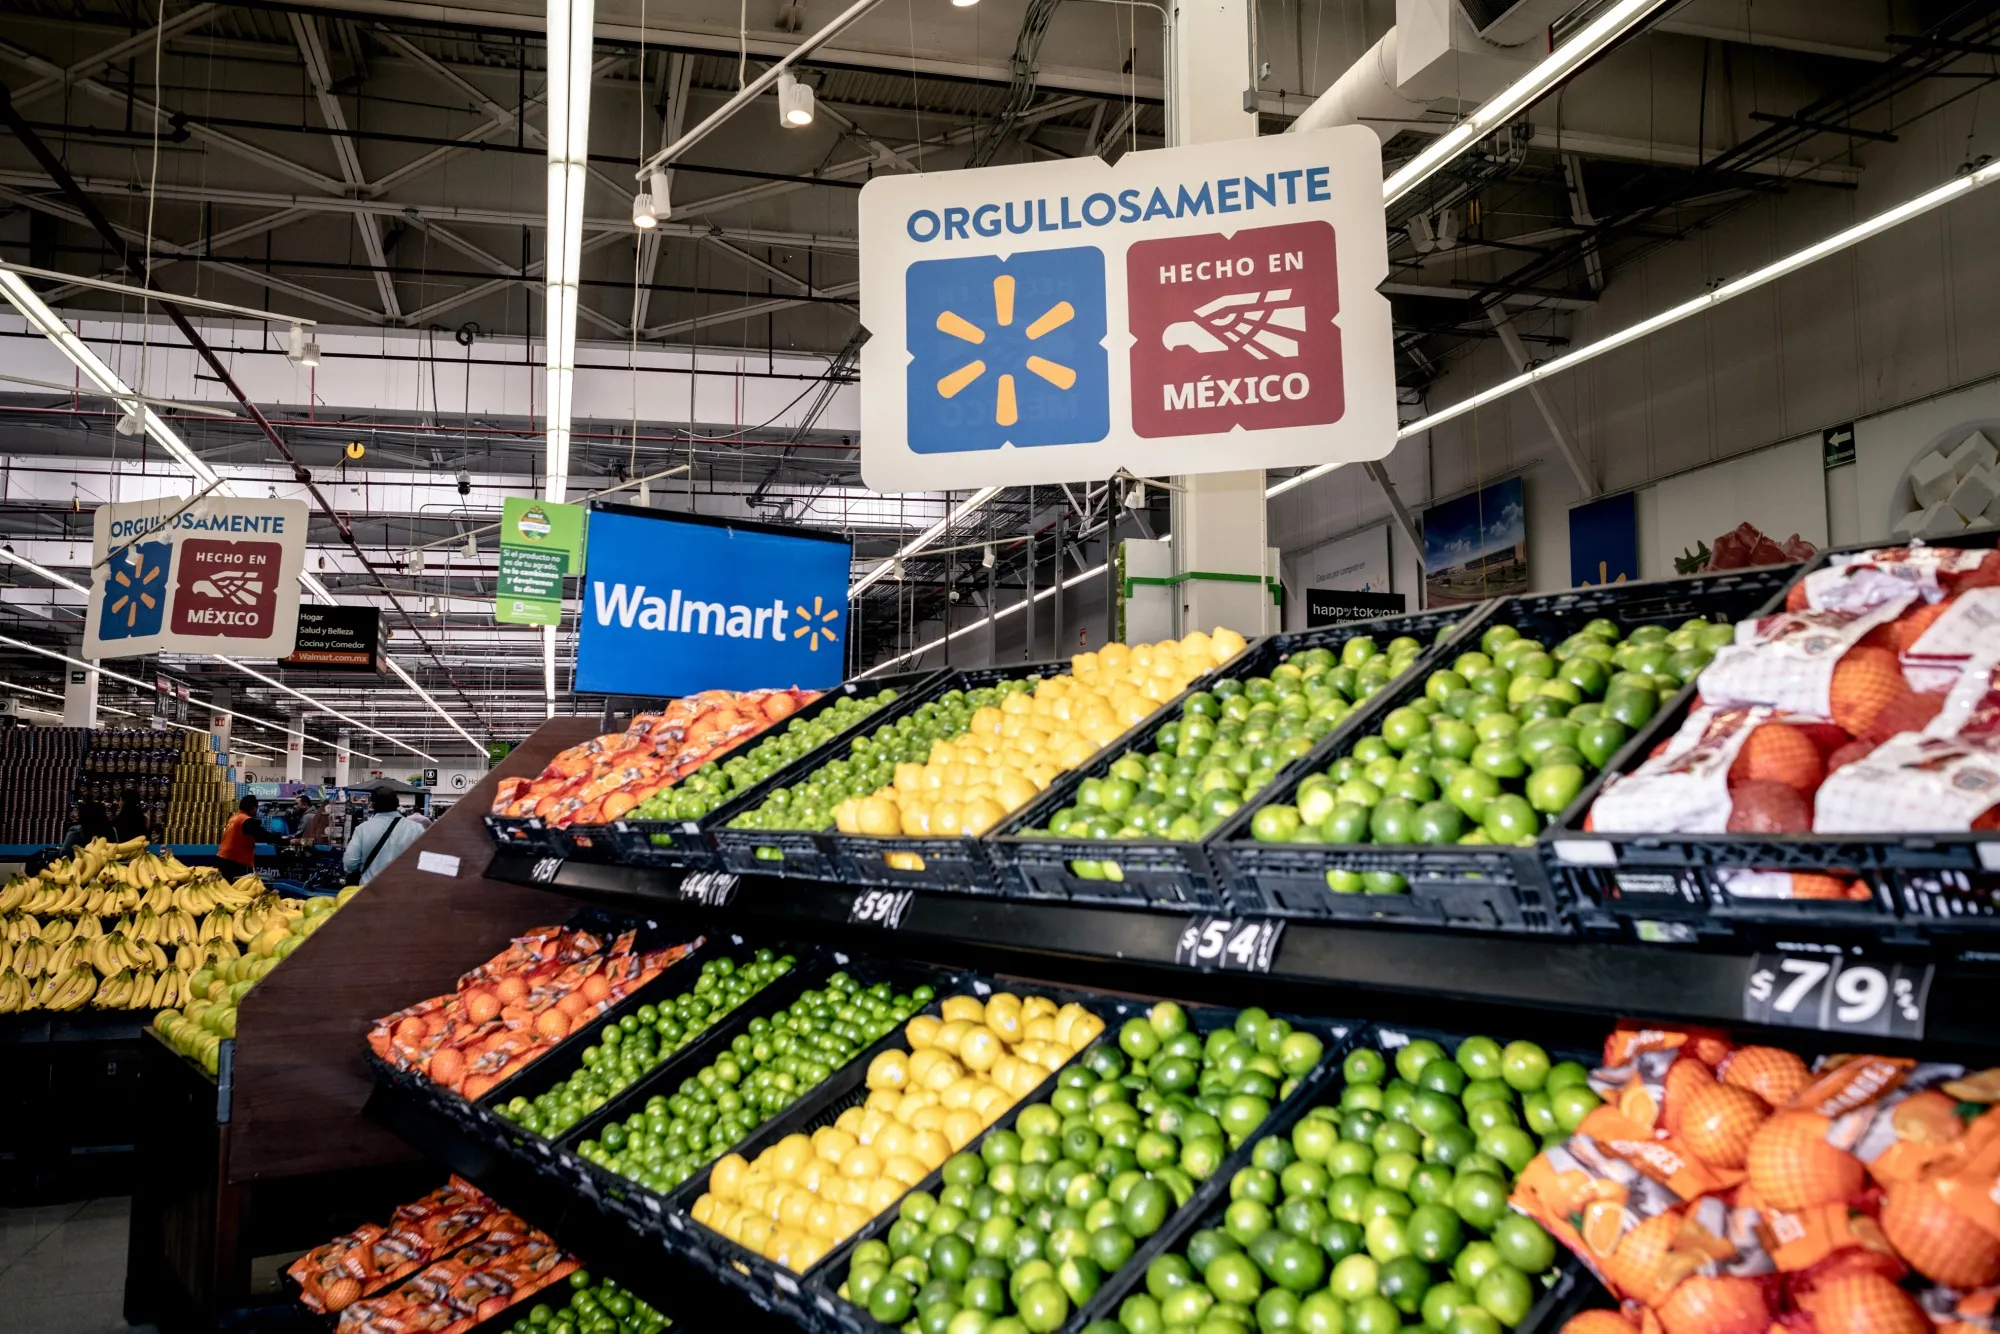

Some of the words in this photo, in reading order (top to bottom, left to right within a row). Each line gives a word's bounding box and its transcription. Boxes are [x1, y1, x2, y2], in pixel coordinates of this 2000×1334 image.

[907, 166, 1331, 243] ORGULLOSAMENTE
[1159, 255, 1254, 284] HECHO
[1269, 251, 1304, 273] EN
[1163, 372, 1310, 412] MÉXICO
[196, 552, 243, 564] HECHO
[249, 554, 266, 565] EN
[518, 552, 551, 561] producto
[187, 608, 259, 626] MÉXICO
[300, 613, 323, 622] Hogar
[594, 581, 788, 642] Walmart
[299, 653, 367, 662] Walmart.com.mx
[331, 641, 365, 649] Comedor
[1181, 920, 1261, 965] $54
[1749, 958, 1888, 1023] $79
